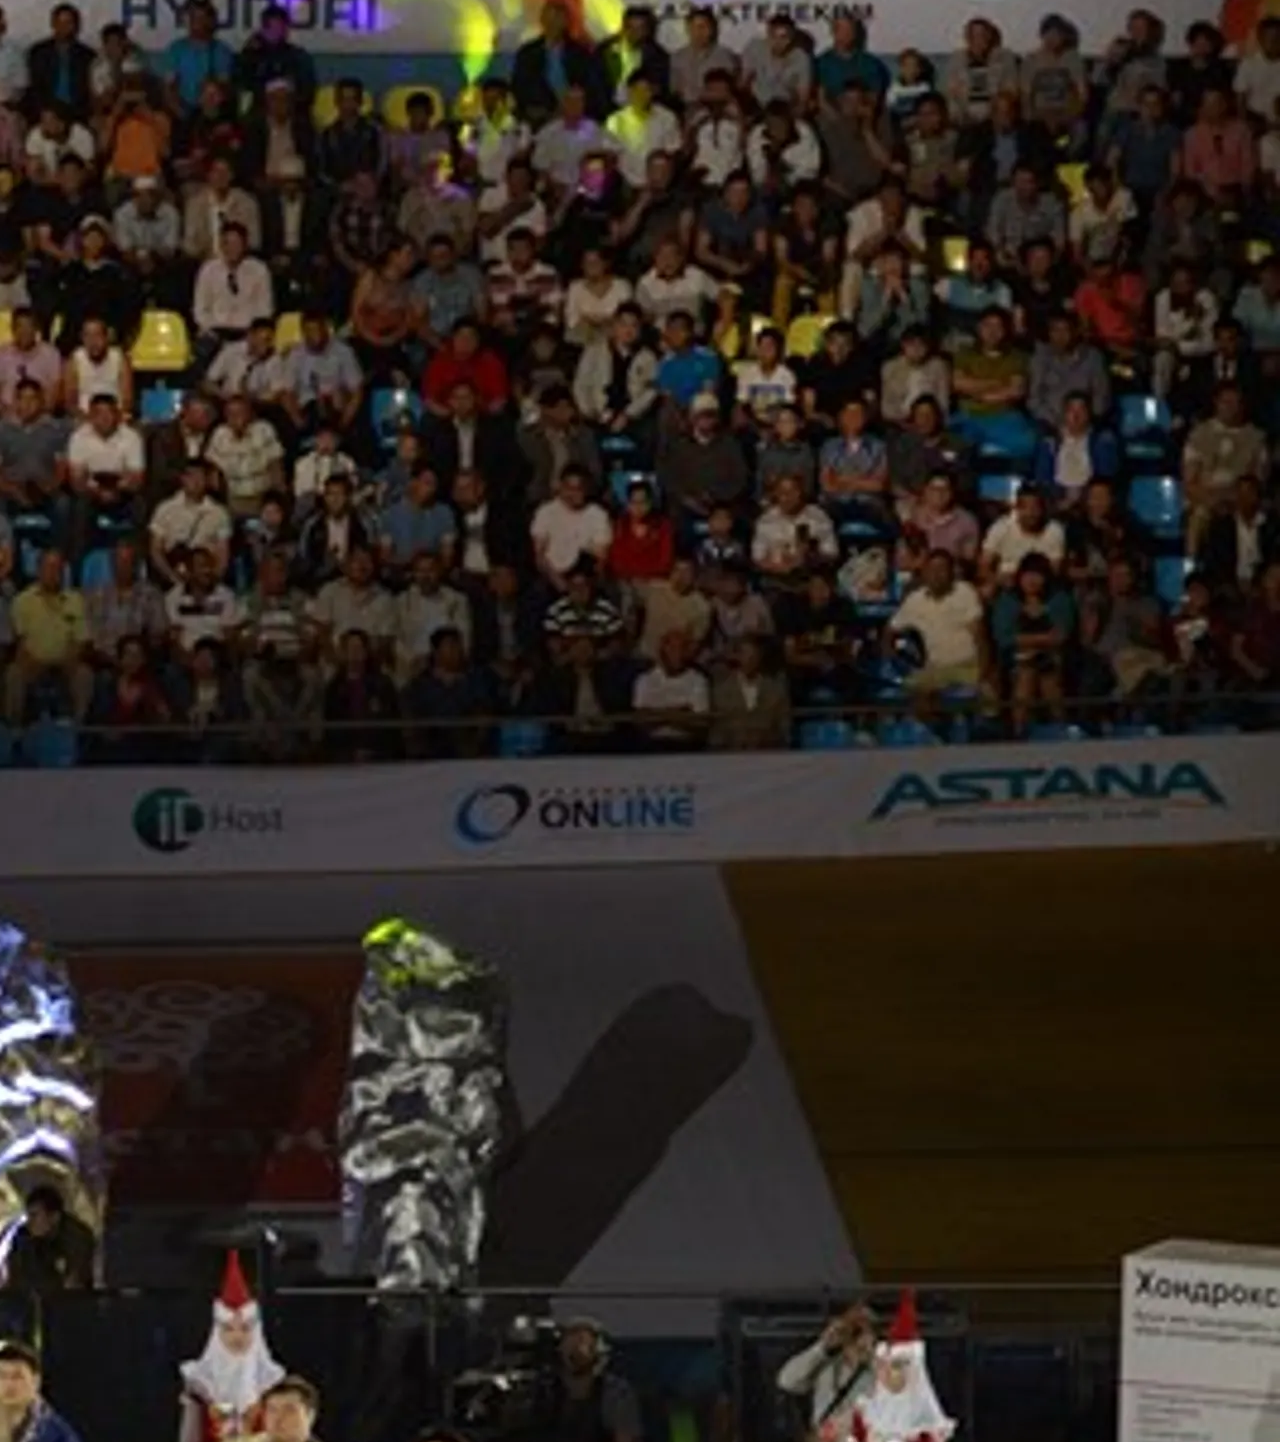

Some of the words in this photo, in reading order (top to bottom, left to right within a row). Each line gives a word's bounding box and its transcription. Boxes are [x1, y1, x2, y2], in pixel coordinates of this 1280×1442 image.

[870, 761, 1226, 818] ASTANA
[211, 800, 282, 833] Host
[539, 798, 694, 829] ONLINE
